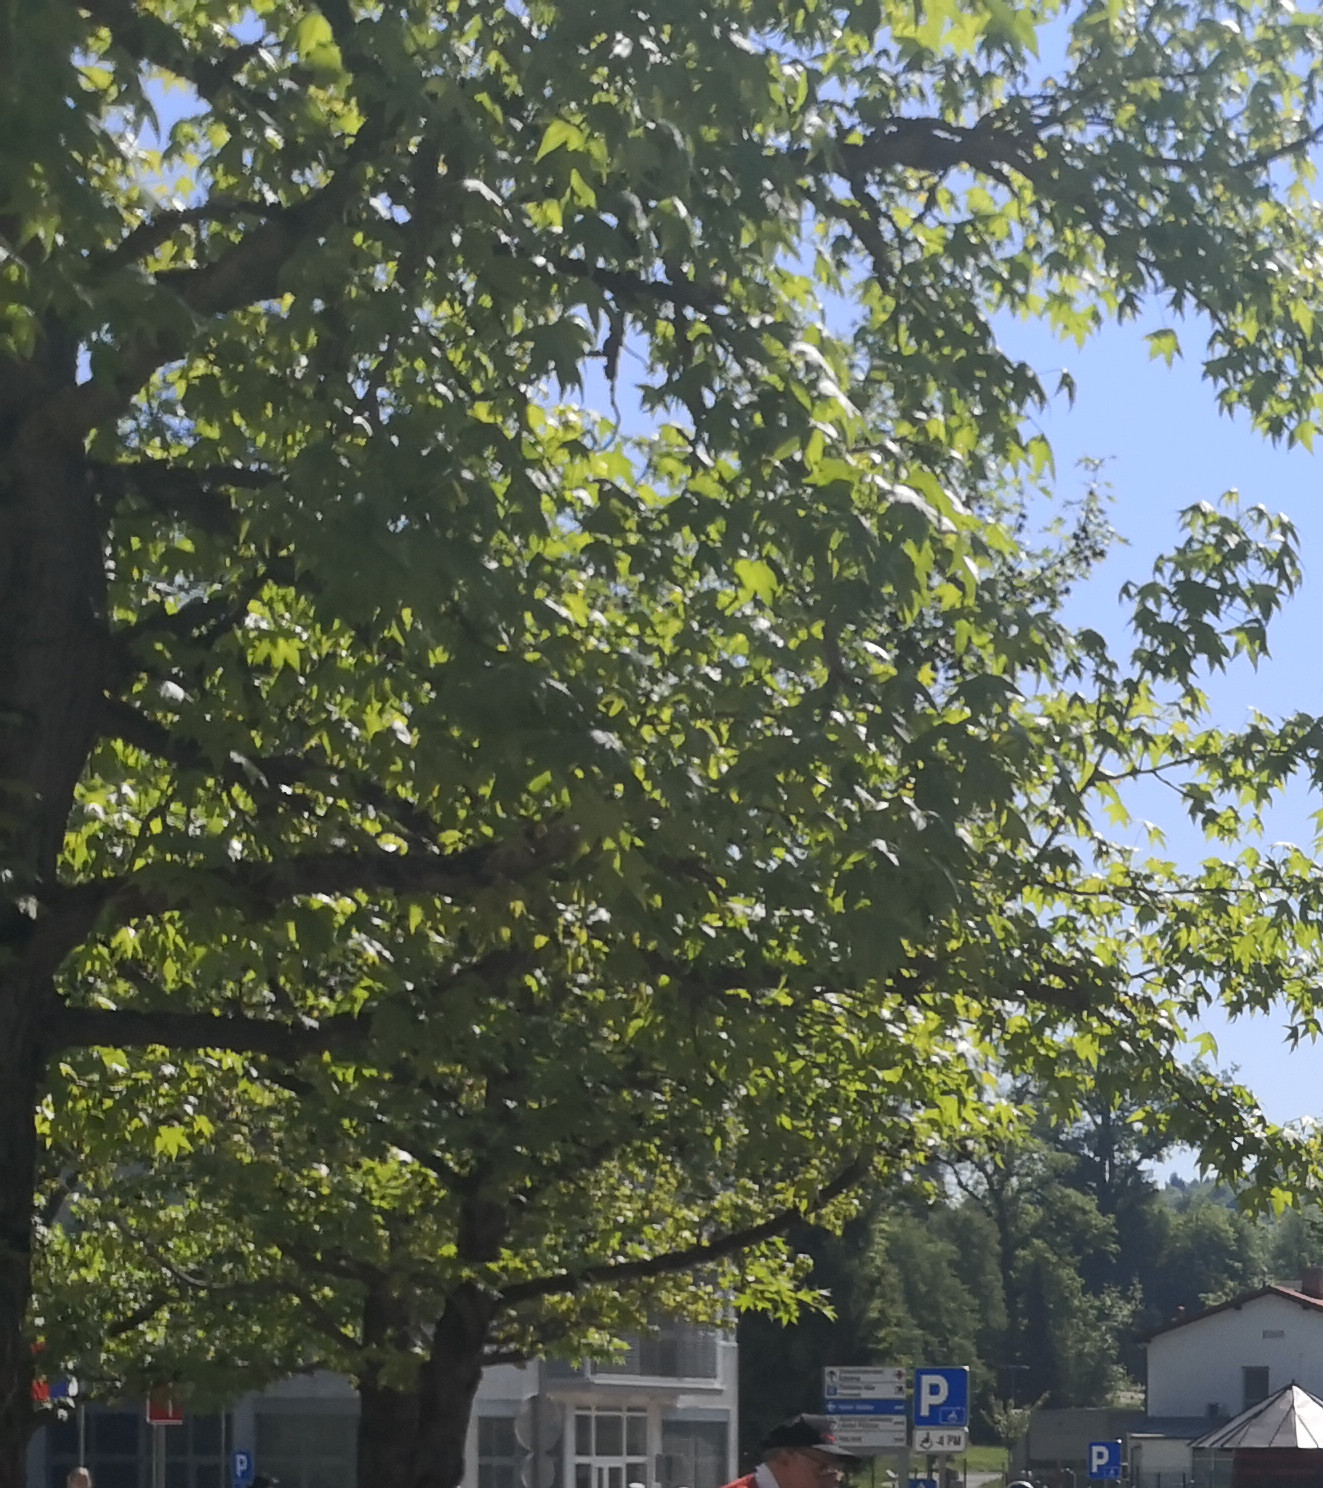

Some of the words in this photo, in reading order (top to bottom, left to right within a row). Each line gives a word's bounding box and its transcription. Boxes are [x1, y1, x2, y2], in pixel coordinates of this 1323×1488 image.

[920, 1374, 949, 1417] P
[235, 1453, 248, 1477] P
[1091, 1445, 1110, 1473] P
